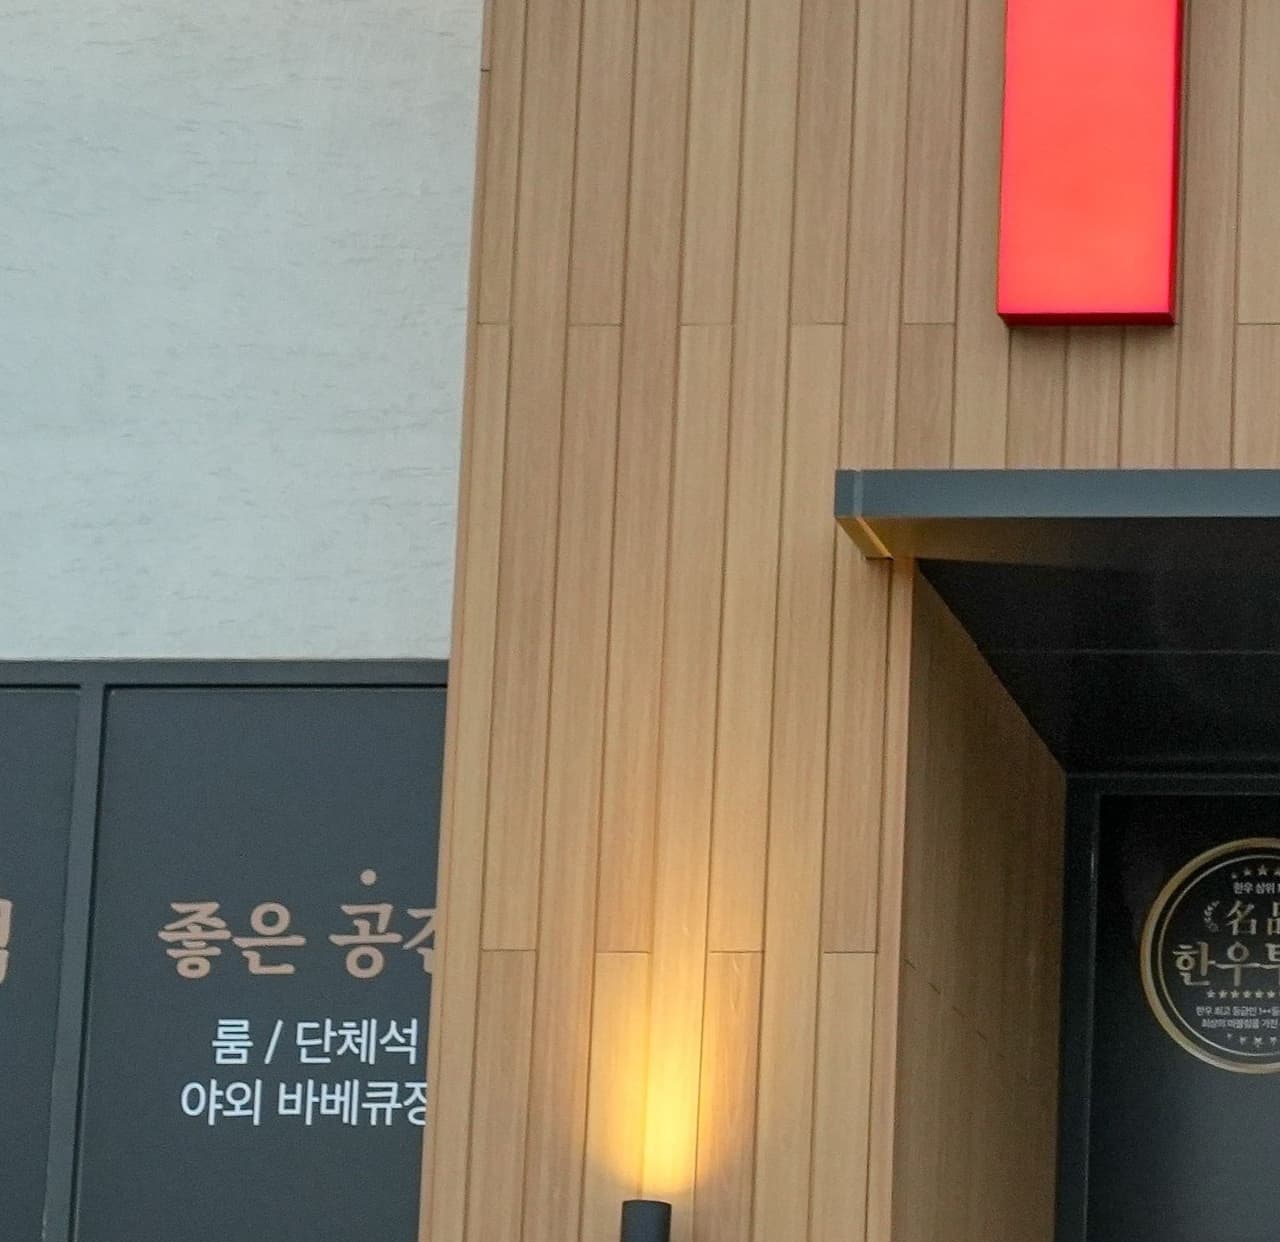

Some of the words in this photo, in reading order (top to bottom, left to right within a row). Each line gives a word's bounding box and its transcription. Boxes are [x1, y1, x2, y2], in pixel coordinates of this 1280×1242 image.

[158, 901, 306, 979] 좋은
[211, 1018, 254, 1065] 룸
[295, 1017, 419, 1065] 단체석
[180, 1078, 262, 1126] 야외
